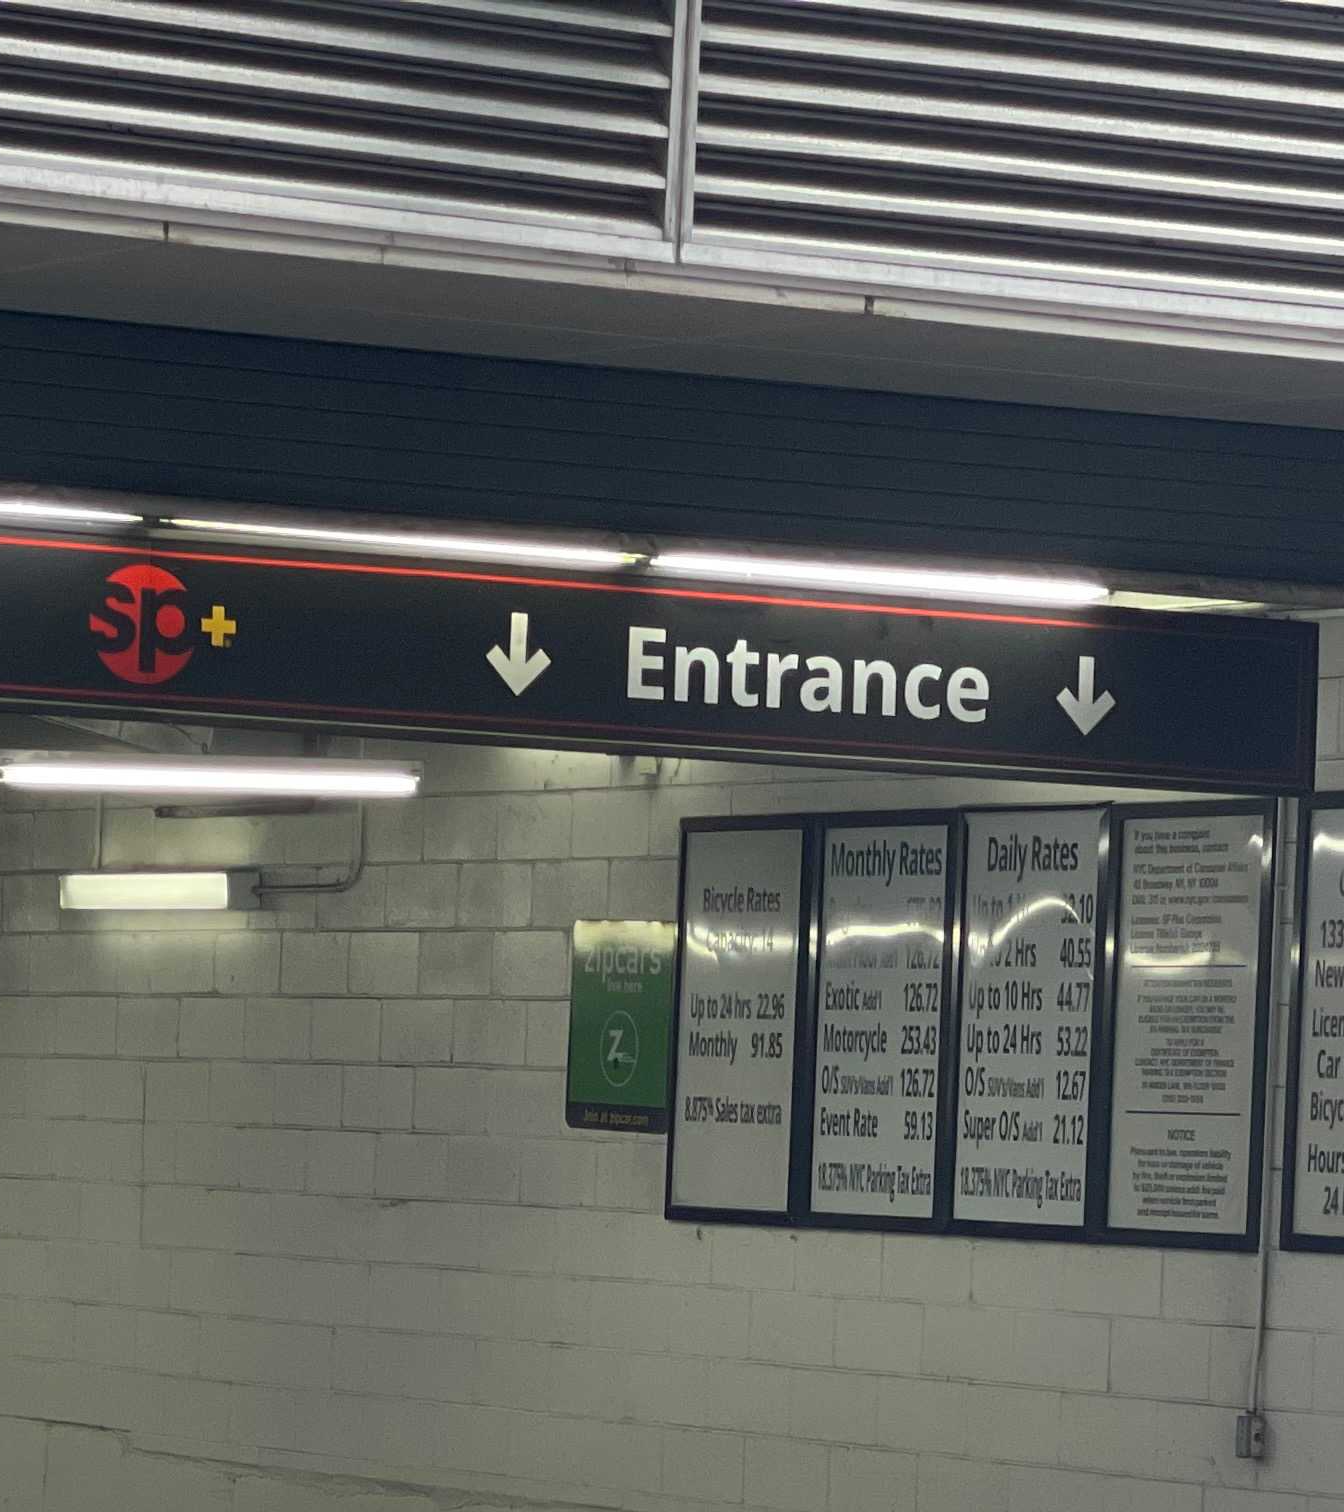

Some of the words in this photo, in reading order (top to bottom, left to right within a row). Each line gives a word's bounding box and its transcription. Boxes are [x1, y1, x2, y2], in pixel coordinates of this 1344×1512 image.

[626, 626, 990, 724] Entrance
[831, 840, 897, 887] Monthly
[899, 841, 943, 876] Rates
[987, 834, 1027, 883] Daily
[1031, 836, 1079, 871] Rates
[703, 886, 744, 915] Bicycle
[747, 887, 781, 912] Rates
[1320, 919, 1344, 948] 133
[1005, 937, 1012, 968] 2
[1015, 935, 1037, 968] Hrs
[1059, 936, 1092, 968] 40.55
[1315, 958, 1344, 988] New
[691, 992, 706, 1025] Up
[706, 996, 717, 1019] to
[720, 994, 733, 1019] 24
[734, 992, 752, 1020] hrs
[825, 980, 860, 1011] Exotic
[904, 982, 938, 1013] 126.72
[969, 980, 984, 1019] Up
[987, 982, 1001, 1011] to
[1005, 980, 1017, 1011] 10
[1021, 981, 1043, 1012] Hrs
[1056, 981, 1090, 1013] 44.77
[688, 1030, 738, 1066] Monthly
[751, 1032, 783, 1059] 91.85
[823, 1022, 888, 1062] Motorcycle
[900, 1024, 937, 1056] 253.43
[967, 1023, 984, 1063] Up
[986, 1024, 1000, 1053] to
[1003, 1023, 1017, 1054] 24
[1020, 1023, 1043, 1055] Hrs
[821, 1064, 839, 1095] O/S
[899, 1066, 936, 1098] 126.72
[1317, 1049, 1341, 1079] Car
[964, 1066, 986, 1097] O/S
[1056, 1071, 1087, 1101] 12.67
[714, 1096, 738, 1123] Sales
[740, 1100, 756, 1124] tax
[757, 1102, 782, 1125] extra
[820, 1106, 851, 1137] Event
[853, 1107, 878, 1138] Rate
[904, 1110, 933, 1141] 59.13
[963, 1109, 997, 1149] Super
[999, 1110, 1021, 1141] O/S
[1053, 1114, 1084, 1145] 21.12
[867, 1161, 896, 1203] Parking
[897, 1164, 910, 1195] Tax
[911, 1165, 931, 1196] Extra
[1012, 1168, 1044, 1208] Parking
[1045, 1170, 1059, 1201] Tax
[1060, 1171, 1082, 1202] Extra
[1323, 1186, 1339, 1215] 24
